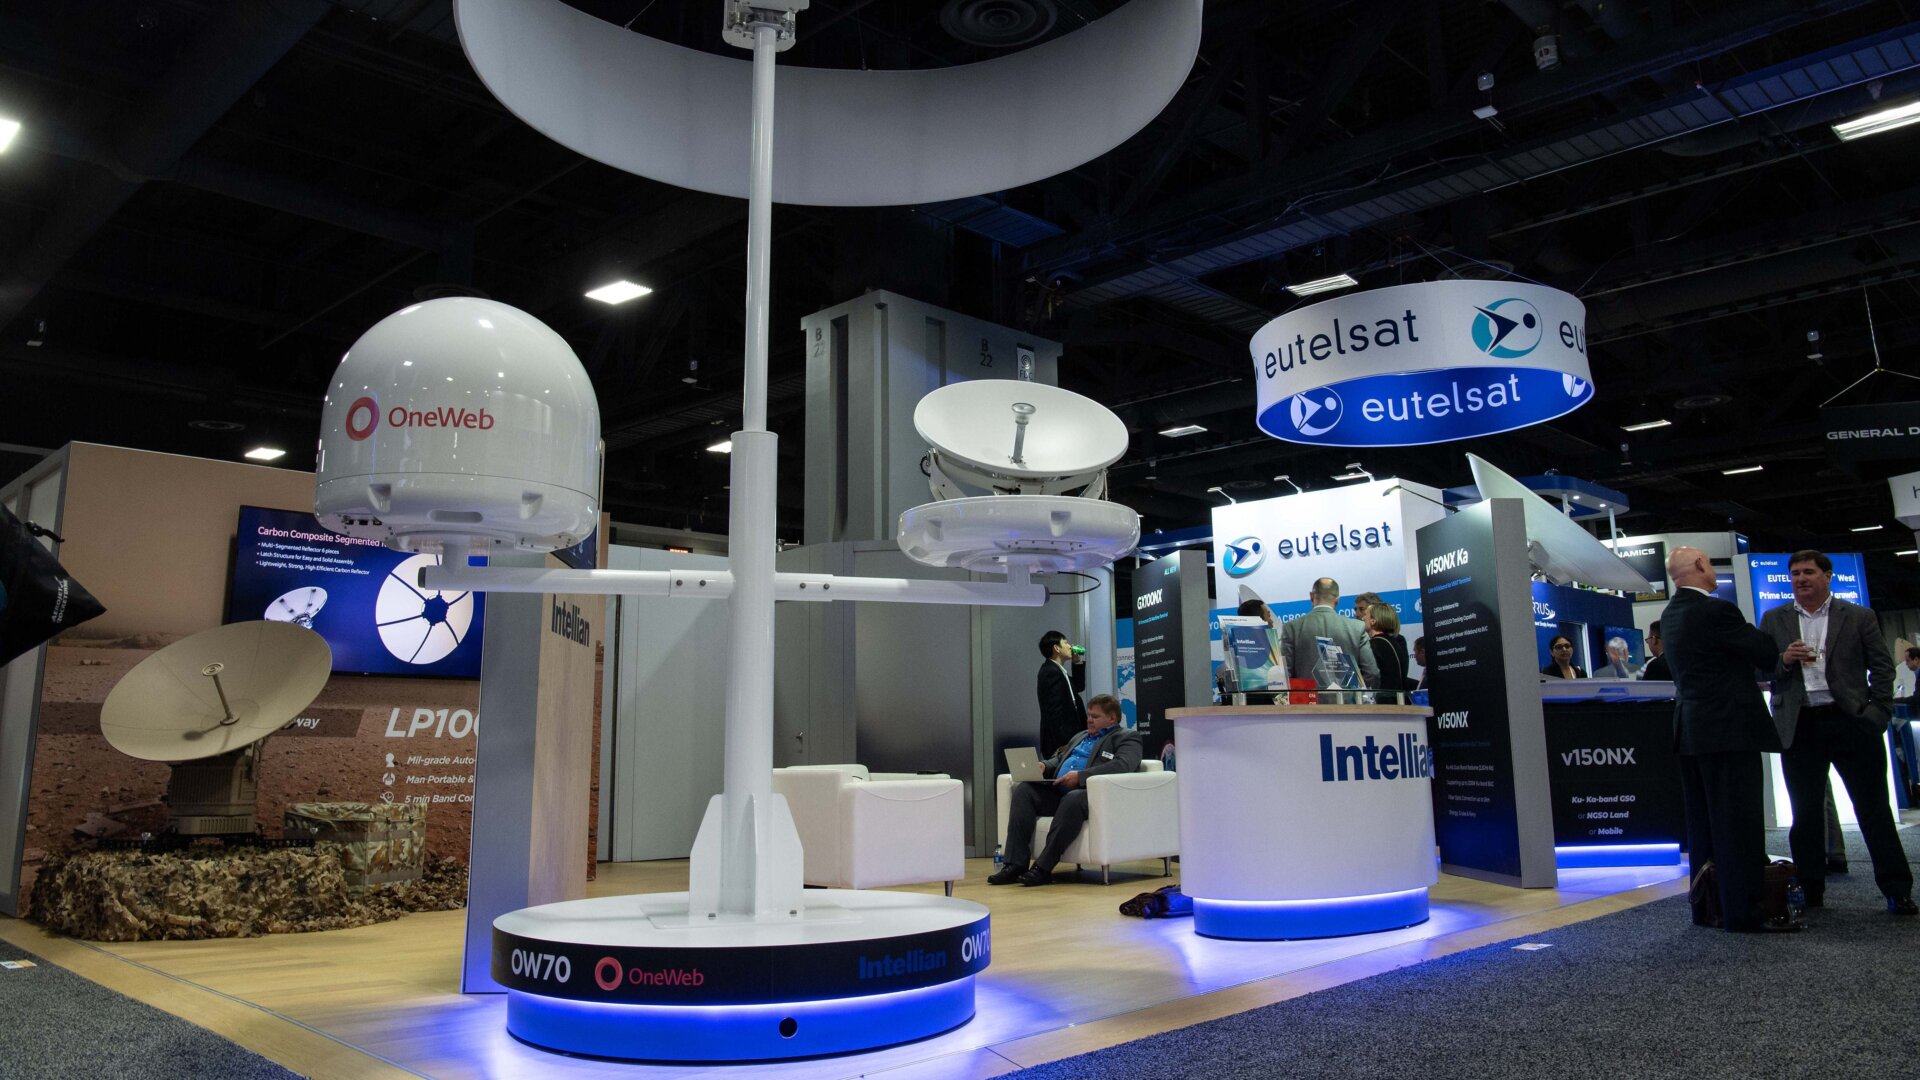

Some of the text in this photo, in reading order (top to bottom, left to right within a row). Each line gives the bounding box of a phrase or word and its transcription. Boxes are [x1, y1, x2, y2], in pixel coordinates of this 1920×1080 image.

[816, 327, 822, 341] B
[1559, 321, 1585, 354] eu
[982, 338, 989, 351] B
[1265, 309, 1419, 379] eutelsat
[980, 352, 993, 367] 22
[1362, 373, 1521, 423] eutelsat
[388, 406, 495, 430] OneWeb
[1826, 428, 1904, 440] GENERAL
[257, 526, 289, 538] Carbon
[290, 529, 334, 542] Composite
[335, 534, 380, 547] Segmented
[1278, 521, 1392, 558] eutelsat
[261, 541, 302, 551] Multi-Segmented
[302, 545, 322, 553] Reflector
[274, 552, 295, 560] Structure
[334, 558, 354, 566] Assembly
[1425, 547, 1469, 577] v150NX Ka
[1767, 574, 1856, 583] EUTEL West
[1759, 591, 1780, 600] Prime
[1781, 591, 1796, 600] loca
[1834, 590, 1859, 600] growth
[551, 593, 590, 648] Intellian
[1437, 710, 1469, 729] v150NX
[407, 755, 450, 766] Mil-grade
[1561, 747, 1637, 767] v150NX
[405, 774, 474, 784] Man Portable &
[404, 794, 411, 804] 5
[412, 794, 430, 804] min
[432, 794, 456, 803] Band
[1586, 795, 1618, 803] Ka-band
[1586, 811, 1608, 819] NGSO
[1609, 811, 1629, 819] Land
[1597, 827, 1624, 835] Mobile
[511, 948, 571, 983] OW70
[628, 968, 704, 986] OneWeb
[858, 949, 947, 979] Intellian
